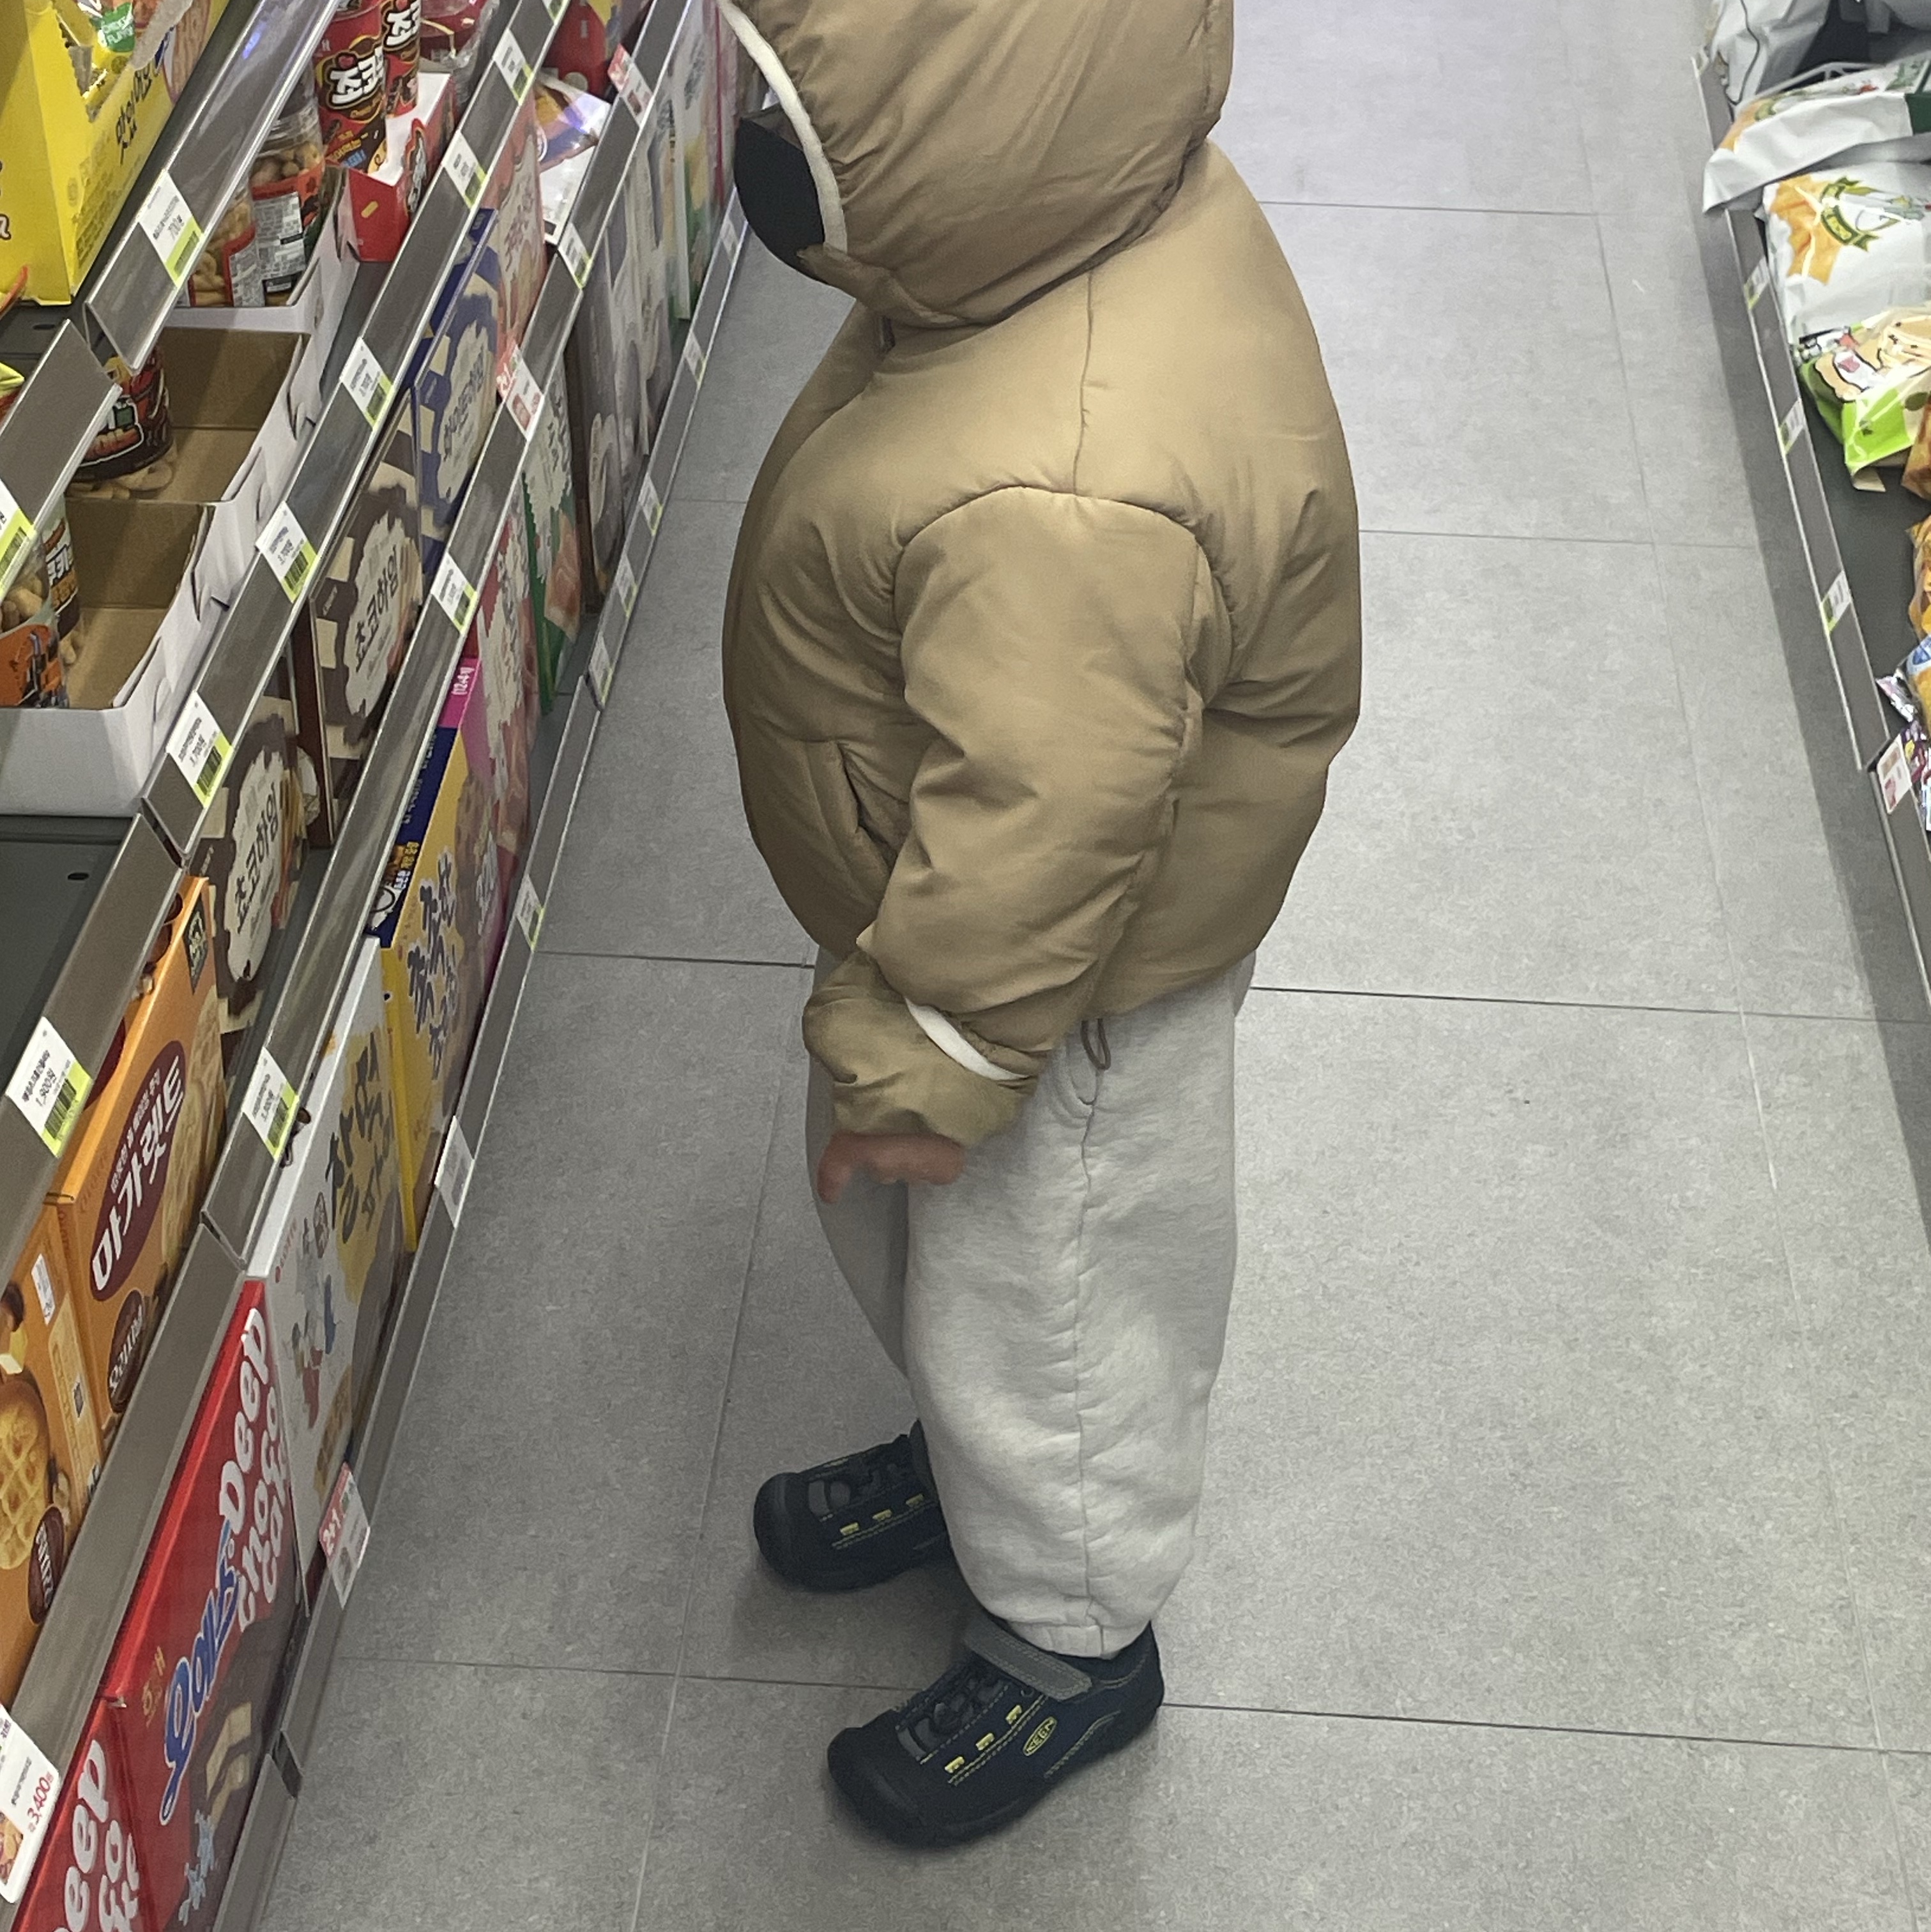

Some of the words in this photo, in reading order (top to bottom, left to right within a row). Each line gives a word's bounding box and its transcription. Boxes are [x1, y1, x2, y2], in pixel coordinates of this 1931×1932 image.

[355, 545, 399, 673] 초코하임
[235, 781, 279, 934] 초코하임
[91, 1054, 184, 1291] 마가렛트
[219, 1307, 268, 1535] Deep
[1026, 1718, 1055, 1754] KEEN
[54, 1740, 109, 1931] eep
